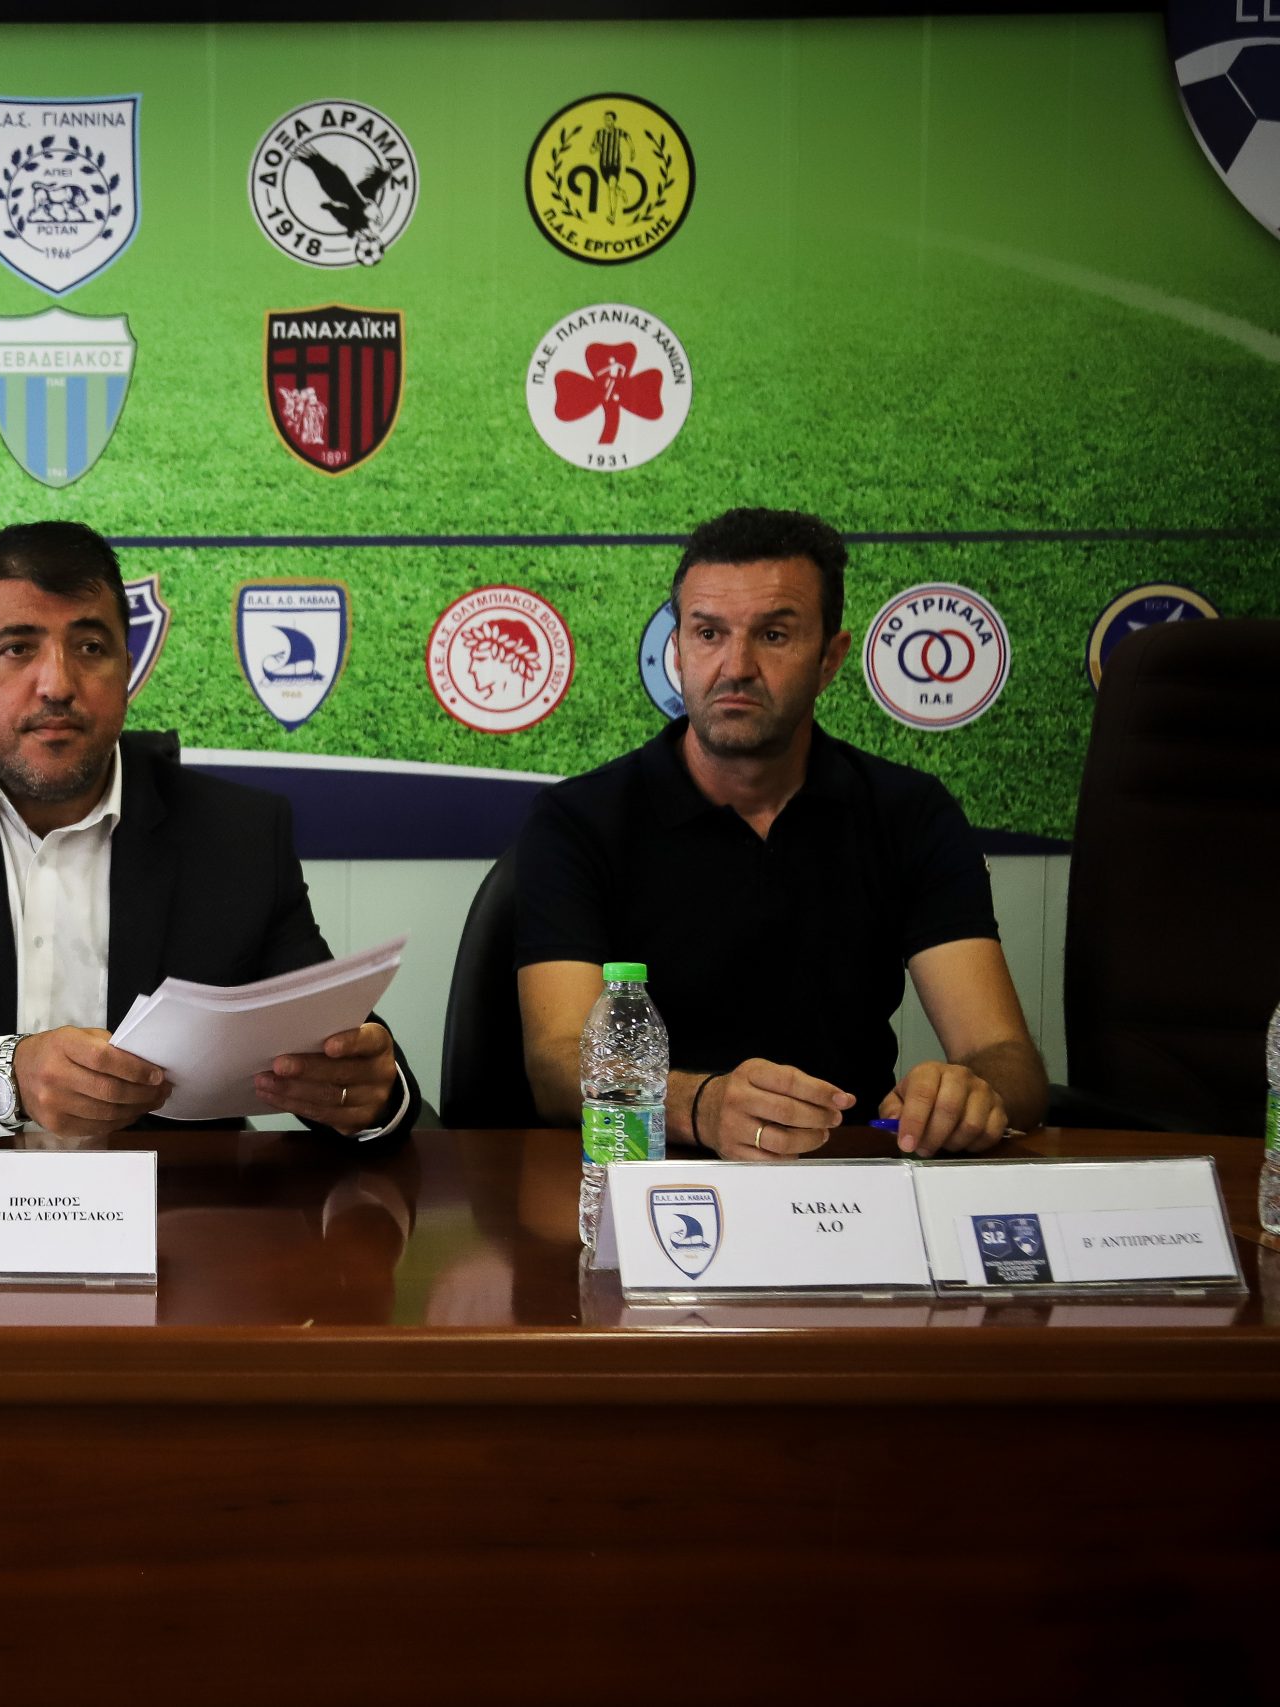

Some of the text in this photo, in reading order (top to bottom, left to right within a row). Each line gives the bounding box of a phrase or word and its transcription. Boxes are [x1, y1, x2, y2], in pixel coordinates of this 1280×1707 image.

[42, 111, 126, 127] ΓΙΑΝΝΙΝΑ
[259, 108, 408, 190] ΔΟΞΑ ΔΡΑΜΑΣ
[267, 206, 322, 257] 1918
[543, 208, 673, 254] Π.Α.Ε. ΕΡΓΟΤΕΛΗΣ
[44, 247, 72, 259] 1966
[272, 317, 396, 339] ΠΑΝΑΧΑΪΚΗ
[556, 309, 651, 342] ΠΛΑΤΑΝΙΑΣ
[652, 328, 686, 385] ΧΑΝΙΩΝ
[321, 451, 347, 464] 1891
[587, 453, 628, 467] 1931
[299, 595, 336, 605] ΚΑΒΑΛΑ
[452, 593, 540, 622] ΟΛΥΜΠΙΑΚΟΣ
[880, 597, 993, 647] ΑΟ ΤΡΙΚΑΛΑ
[540, 612, 566, 658] ΒΟΛΟΥ
[435, 656, 451, 692] ΠΑΕ
[549, 664, 565, 693] 1937
[9, 1196, 80, 1208] ΠΡΟΕΔΡΟΣ
[791, 1202, 862, 1214] ΚΑΒΑΛΑ
[34, 1211, 124, 1222] ΛΕΟΥΤΣΑΚΟΣ
[816, 1220, 844, 1233] Α.Ο
[982, 1231, 1007, 1244] SL2
[1101, 1232, 1204, 1248] ΑΝΤΙΠΡΟΕΔΡΟΣ
